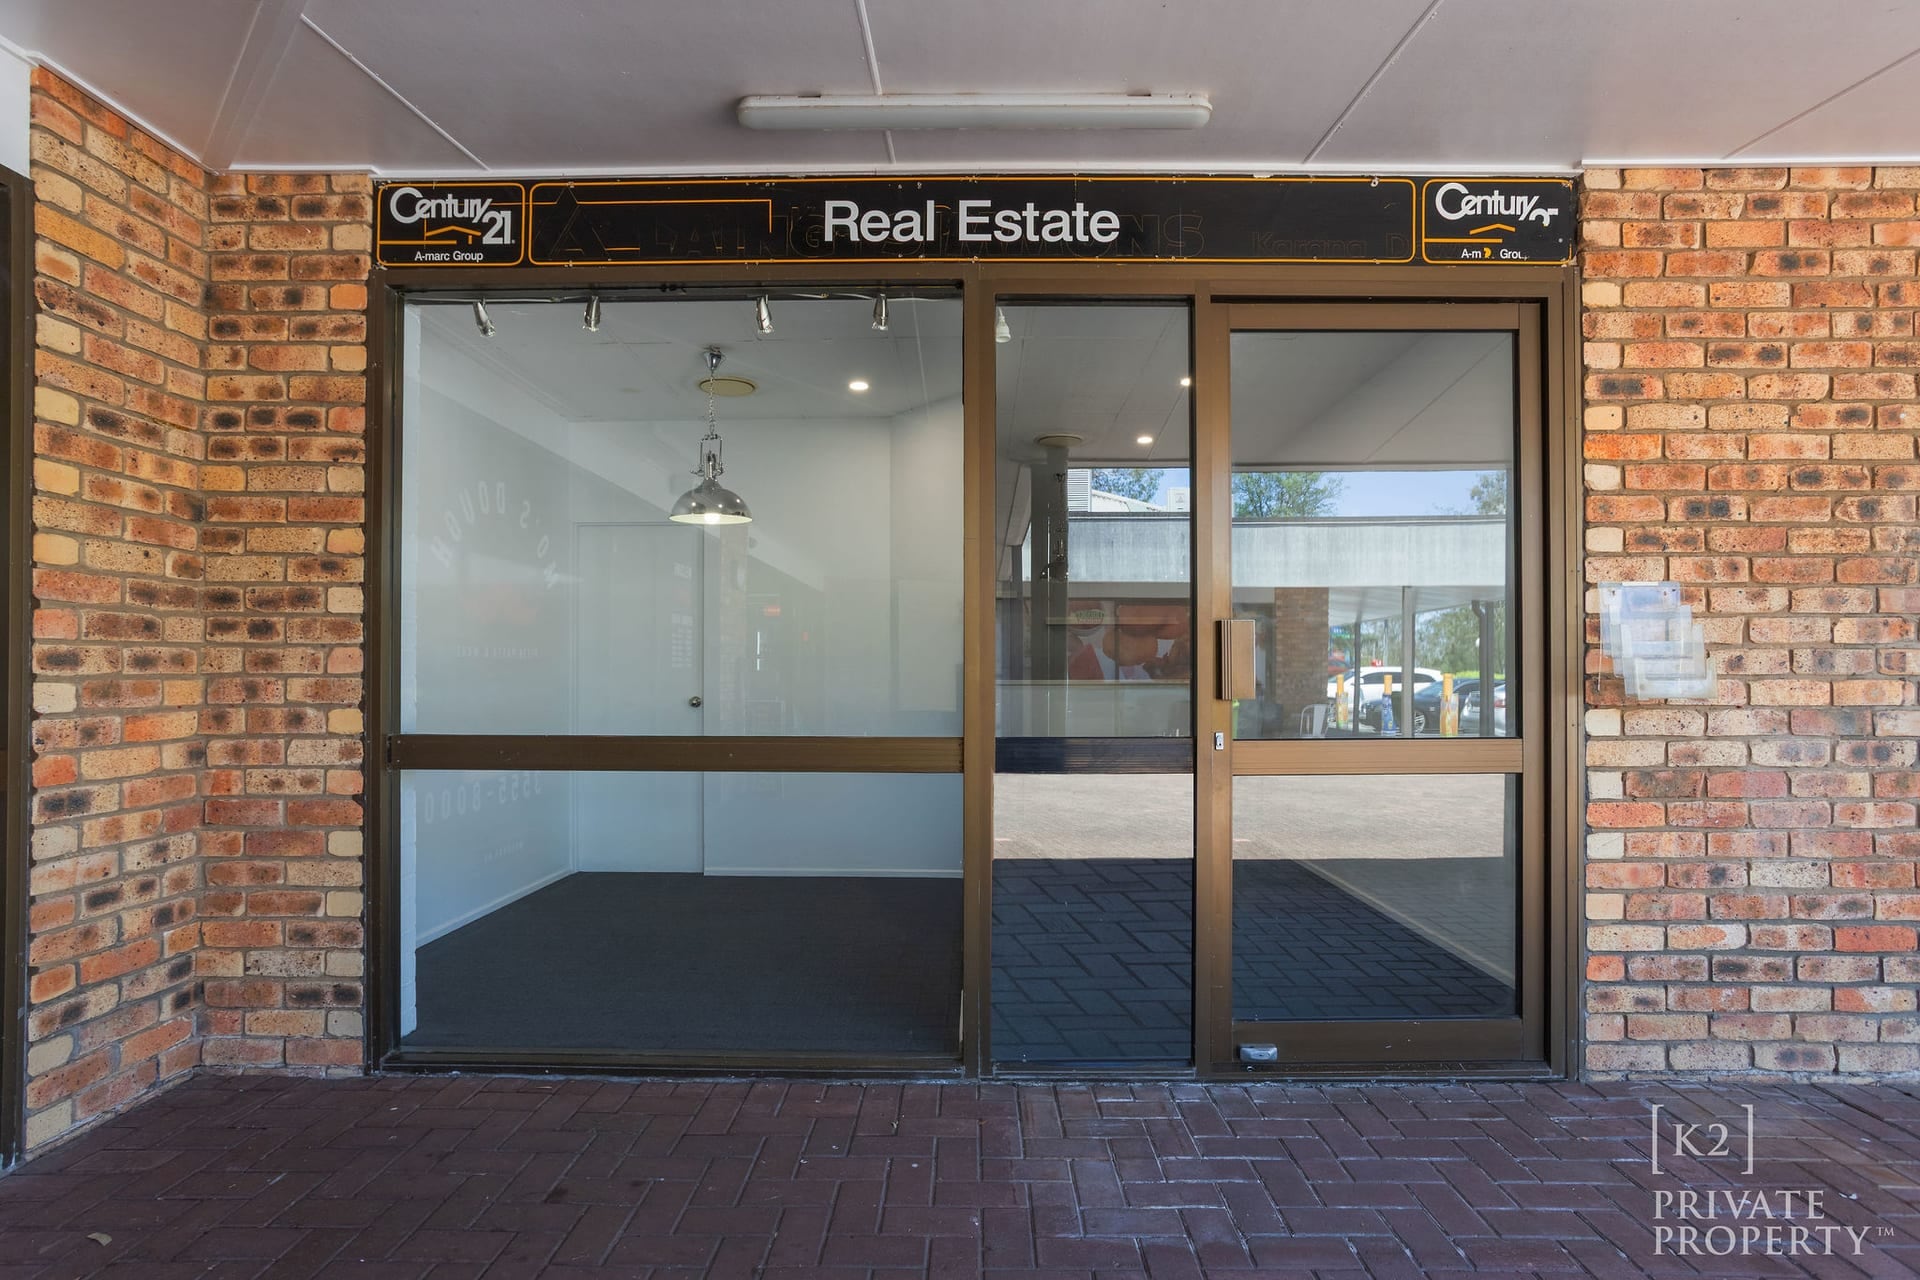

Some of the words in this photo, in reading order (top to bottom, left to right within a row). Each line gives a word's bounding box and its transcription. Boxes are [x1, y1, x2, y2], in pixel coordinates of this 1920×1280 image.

[390, 187, 492, 223] Century
[1435, 182, 1540, 221] Century
[824, 199, 935, 242] Real
[958, 199, 1121, 242] Estate
[414, 251, 450, 262] A-marc
[452, 251, 484, 263] Group
